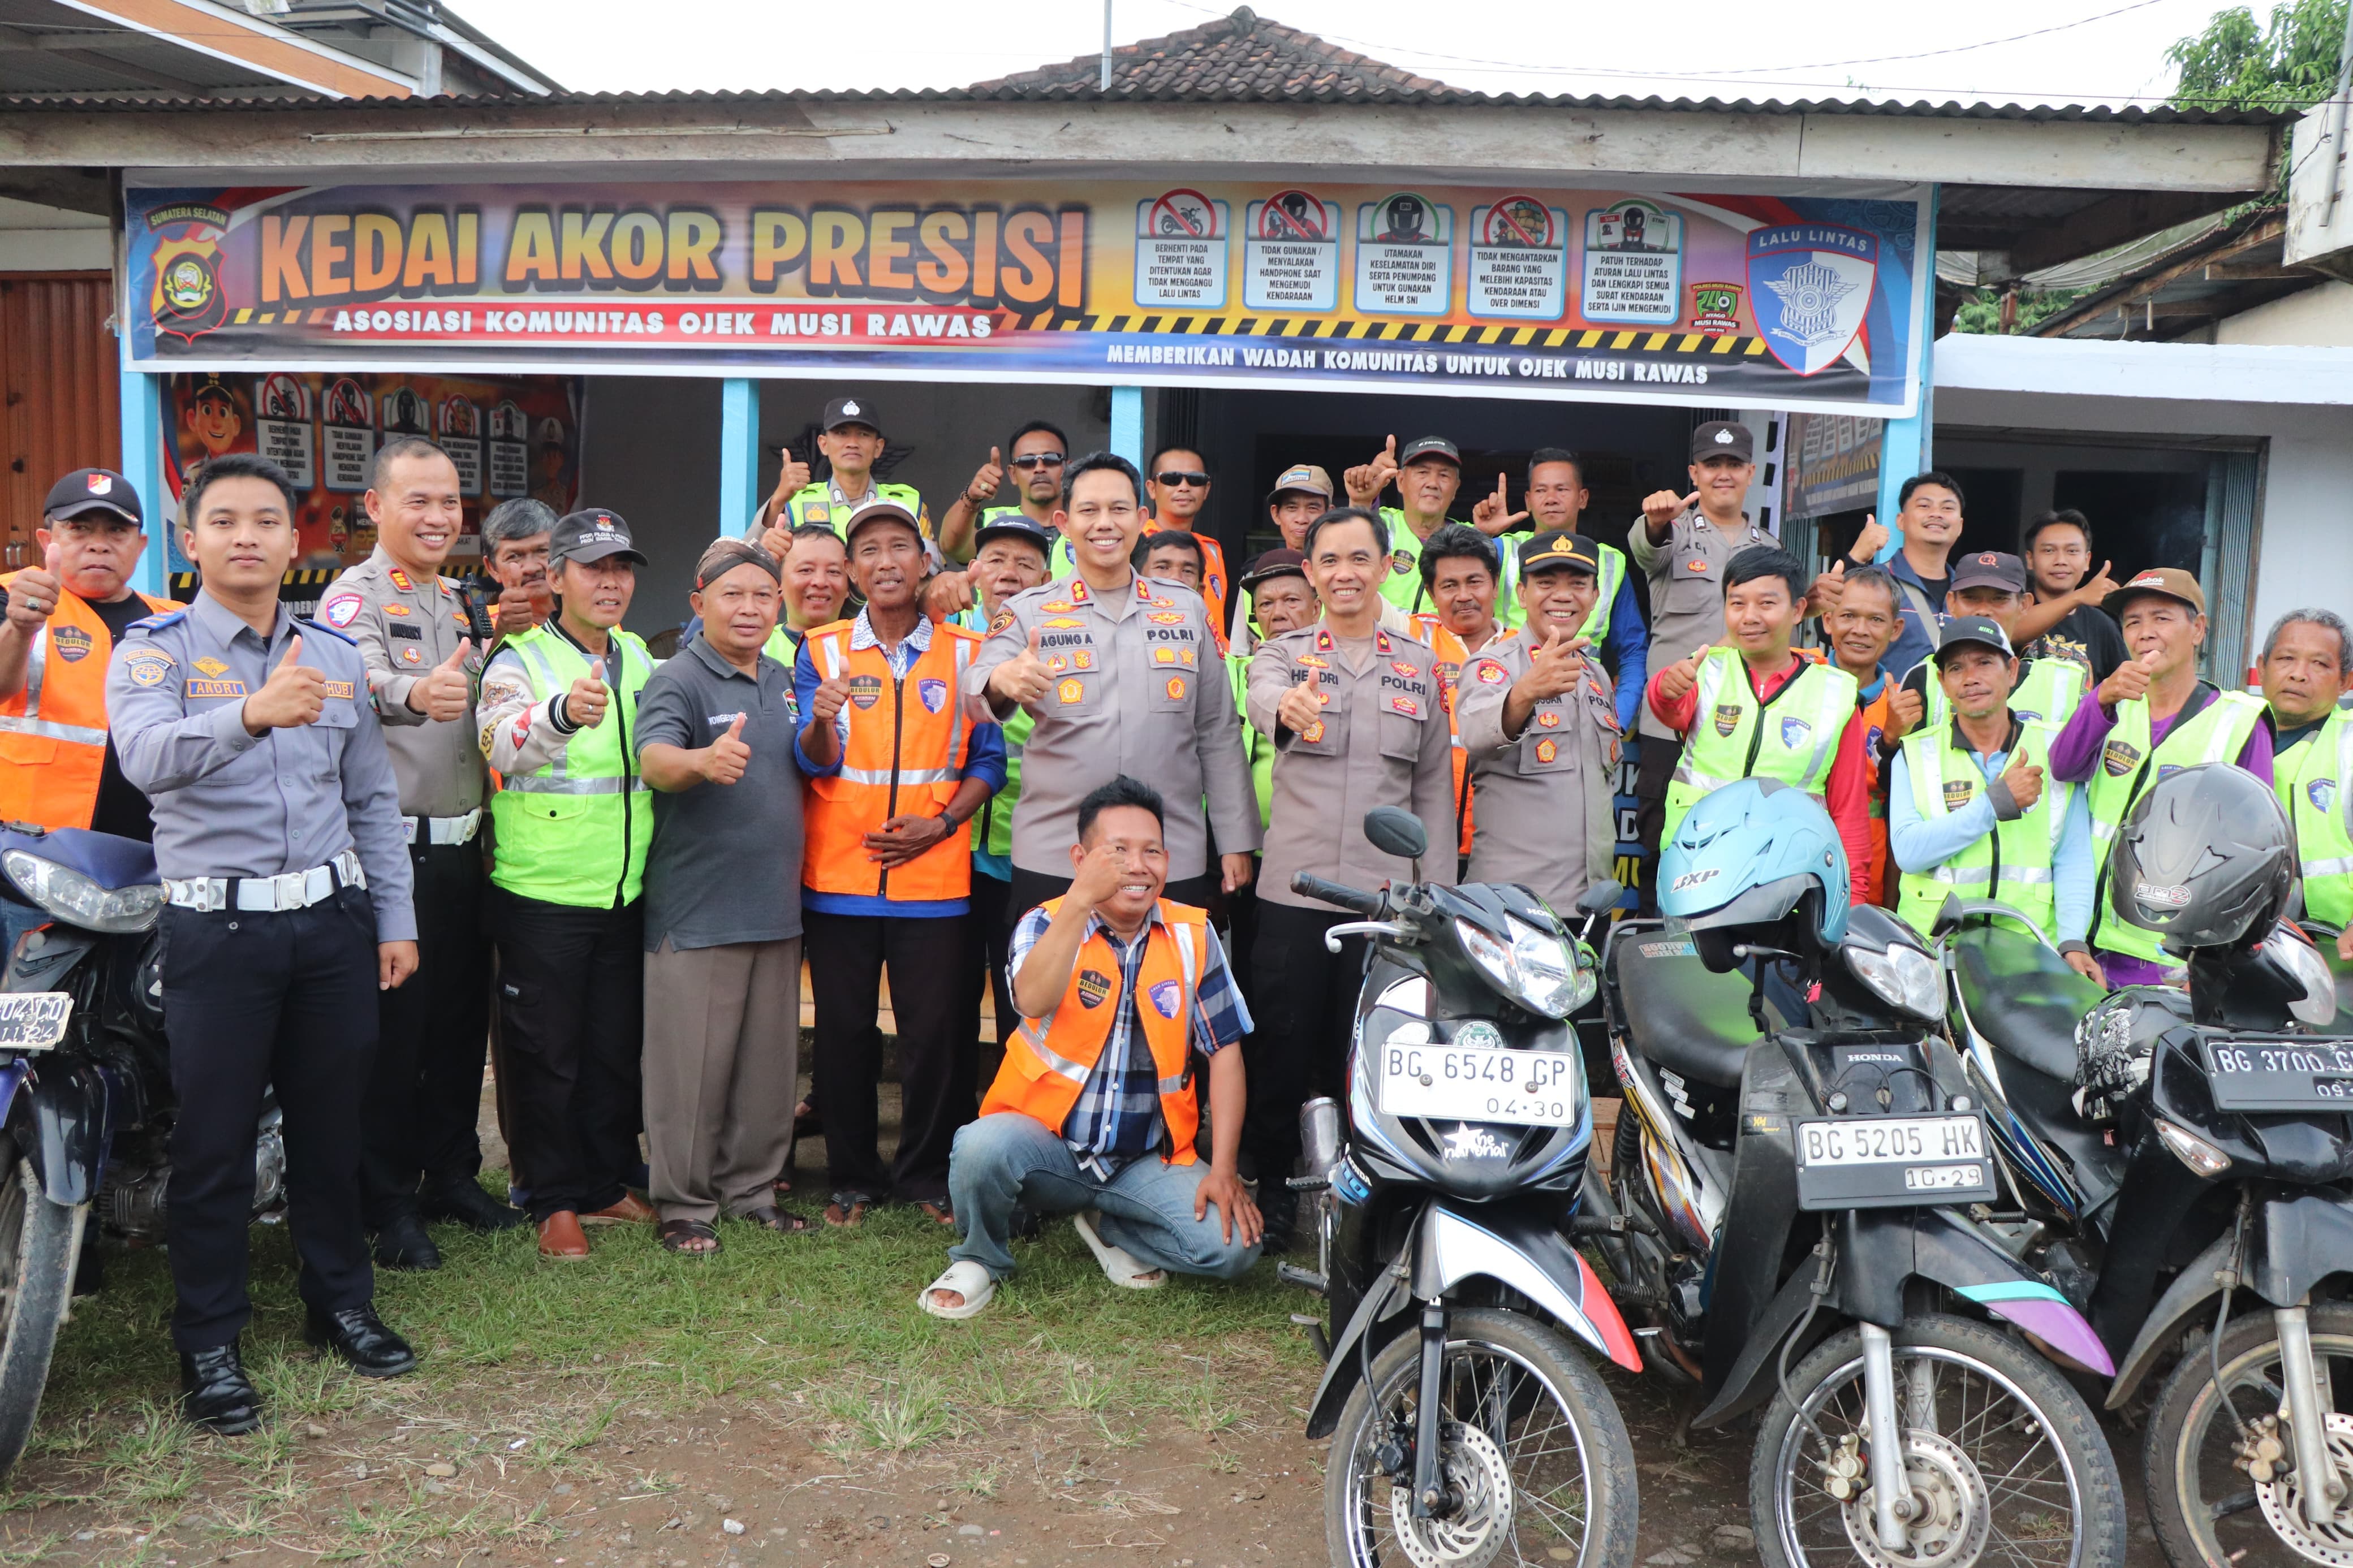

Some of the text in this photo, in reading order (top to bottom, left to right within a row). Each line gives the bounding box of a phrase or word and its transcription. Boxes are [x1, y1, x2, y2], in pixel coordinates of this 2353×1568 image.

[151, 206, 226, 226] SUMATERA SELATAN
[1759, 230, 1868, 252] LALU LINTAS
[1155, 244, 1208, 253] BERHENTI PADA
[1261, 245, 1281, 254] TIDAK
[1283, 246, 1317, 255] GUNAKAN
[1384, 249, 1423, 258] UTAMAKAN
[261, 211, 1084, 309] KEDAI AKOR PRESISI
[1158, 256, 1205, 265] TEMPAT YANG
[1268, 257, 1314, 267] MENYALAKAN
[1500, 252, 1558, 263] MENGANTARKAN
[1601, 256, 1664, 266] PATUH TERHADAP
[1370, 260, 1436, 270] KESELAMATAN DIRI
[1491, 264, 1542, 274] BARANG YANG
[1149, 266, 1212, 276] DITENTUKAN AGAR
[1260, 269, 1321, 278] HANDPHONE SAAT
[1594, 267, 1669, 278] ATURAN LALU LINTAS
[1148, 278, 1213, 287] TIDAK MENGGANGU
[1369, 272, 1436, 282] SERTA PENUMPANG
[1479, 275, 1553, 286] MELEBIHI KAPASITAS
[1269, 280, 1311, 290] MENGEMUDI
[1372, 284, 1432, 293] UNTUK GUNAKAN
[1591, 279, 1670, 290] DAN LENGKAPI SEMUA
[1159, 289, 1201, 299] LALU LINTAS
[1266, 291, 1313, 301] KENDARAAAN
[1484, 287, 1547, 297] KENDARAAN ATAU
[1596, 291, 1664, 301] SURAT KENDARAAN
[1385, 295, 1418, 304] HELM SNI
[1490, 299, 1540, 309] OVER DIMENSI
[1588, 302, 1671, 313] SERTA IJIN MENGEMUDI
[333, 310, 992, 338] ASOSIASI KOMUNITAS OJEK MUSI RAWAS
[1106, 344, 1708, 385] MEMBERIKAN WADAH KOMUNITAS UNTUK OJEK MUSI RAWAS
[1040, 633, 1093, 648] AGUNG A
[1147, 629, 1194, 641] POLRI
[1291, 669, 1339, 685] HEDRI
[196, 681, 239, 696] ANDRI
[326, 683, 351, 696] HUB
[1381, 675, 1426, 696] POLRI
[1079, 979, 1107, 995] BEDULUR
[2217, 1049, 2252, 1073] BG
[2260, 1051, 2325, 1073] 3700
[1389, 1048, 1566, 1086] BG 6548 GP
[1809, 1124, 1977, 1160] BG 5205 HK
[1444, 1141, 1507, 1160] national
